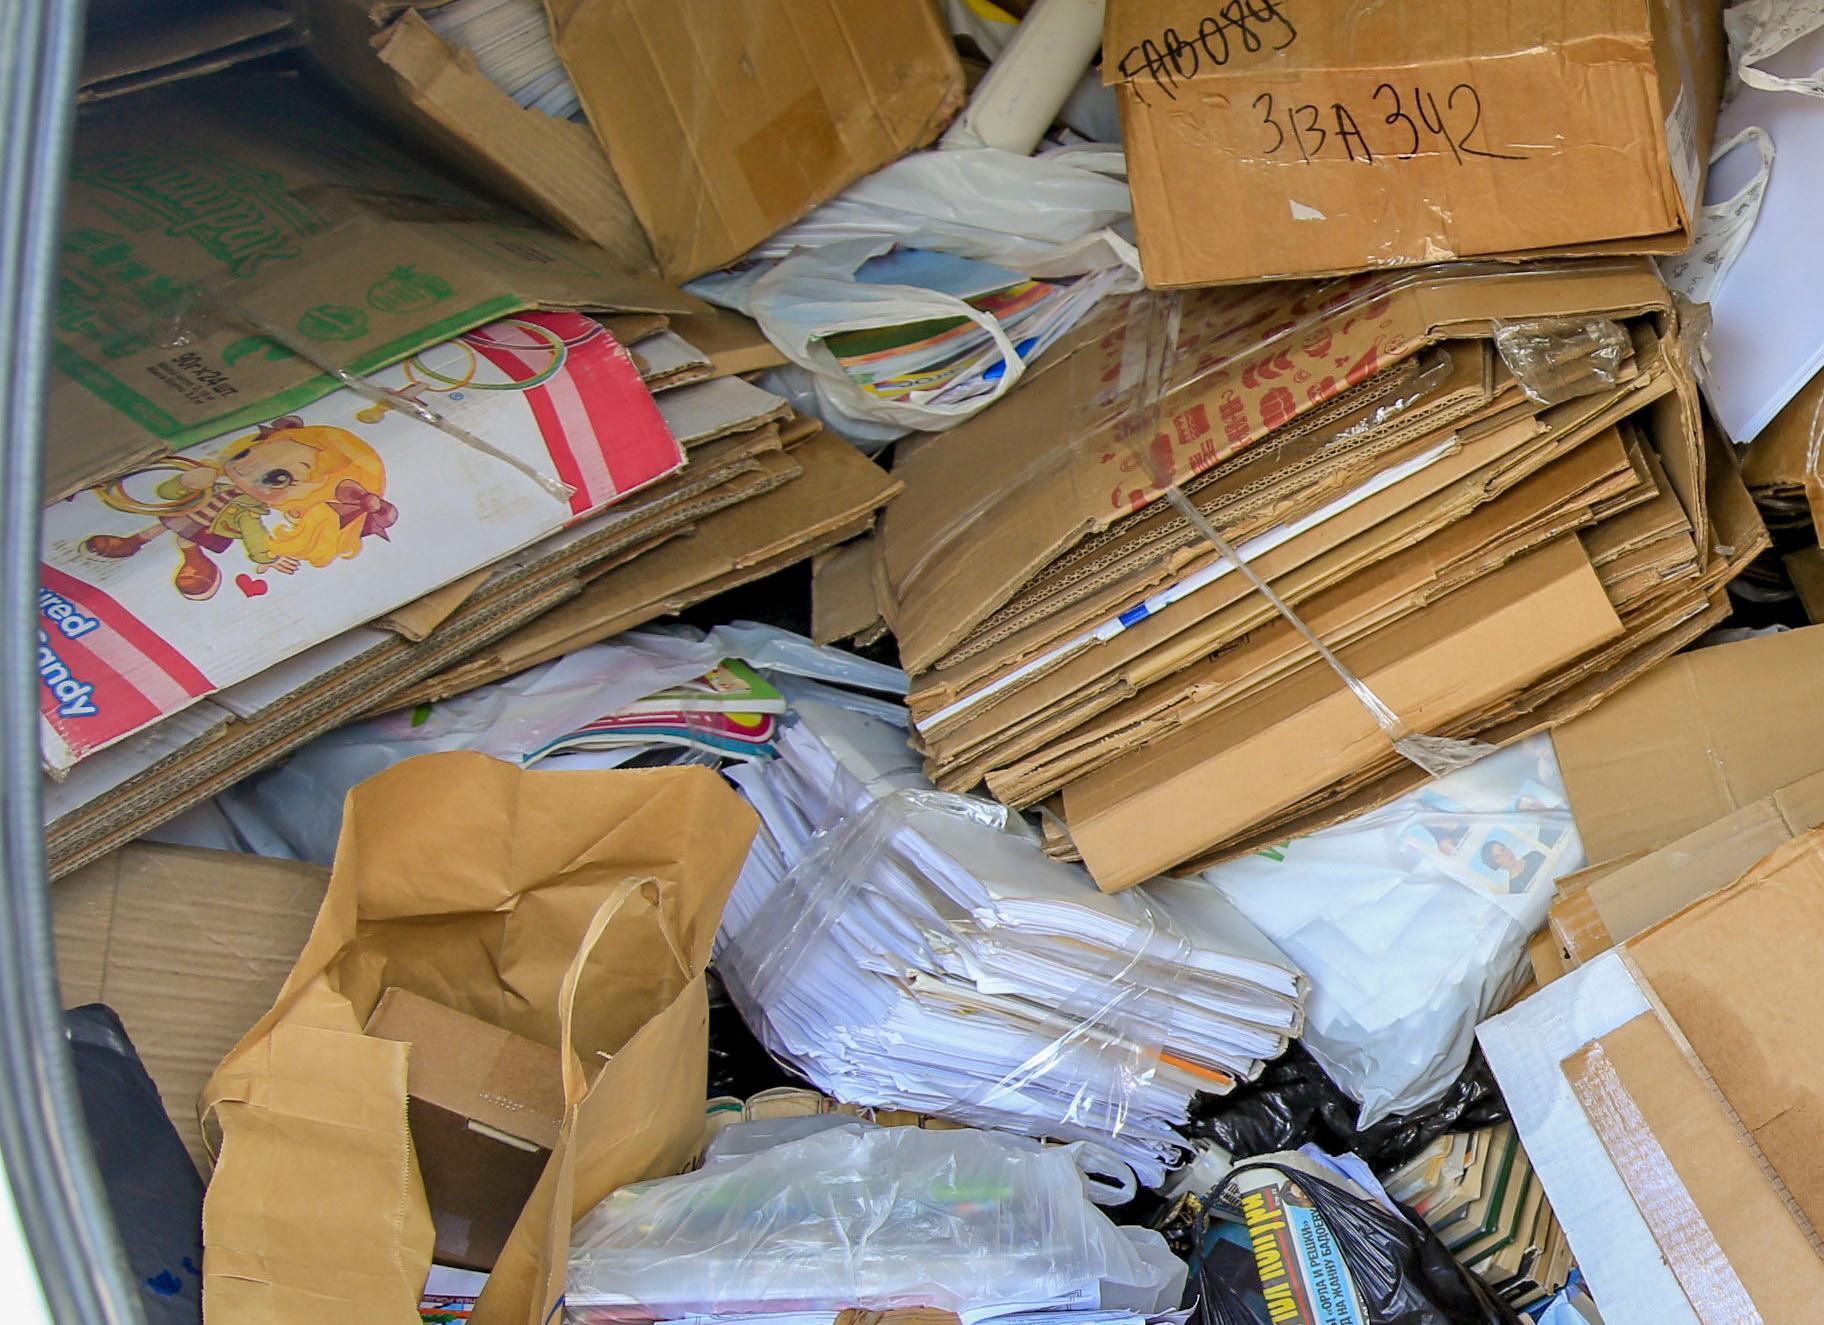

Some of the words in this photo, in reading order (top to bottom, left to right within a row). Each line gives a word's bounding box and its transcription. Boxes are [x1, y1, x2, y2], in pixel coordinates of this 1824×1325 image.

[1316, 1279, 1334, 1317] «ОРЛА
[1327, 1259, 1346, 1300] ЖАННУ
[1337, 1298, 1350, 1319] НА
